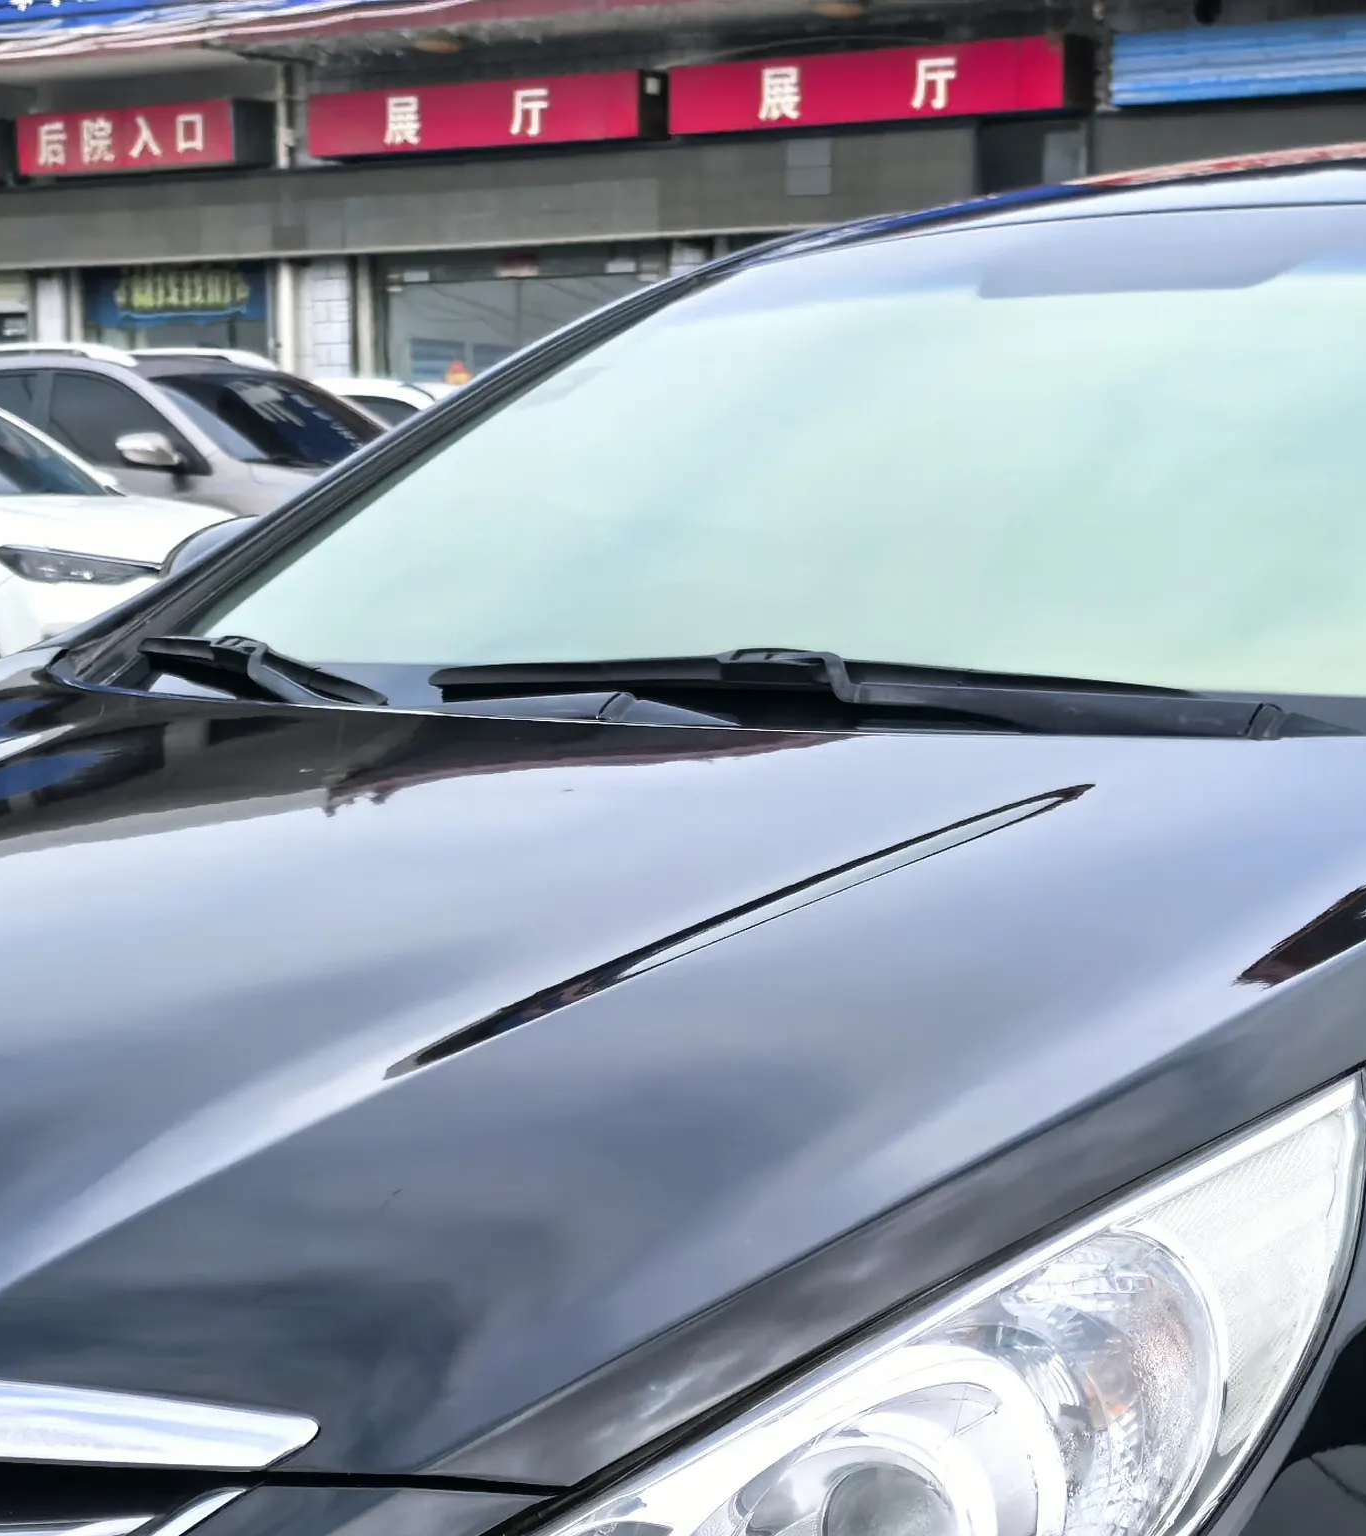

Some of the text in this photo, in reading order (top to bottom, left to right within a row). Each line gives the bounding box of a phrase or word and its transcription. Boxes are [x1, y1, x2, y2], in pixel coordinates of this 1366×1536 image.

[383, 87, 550, 146] 展厅
[757, 56, 958, 122] 展厅
[36, 112, 205, 167] 后院入口
